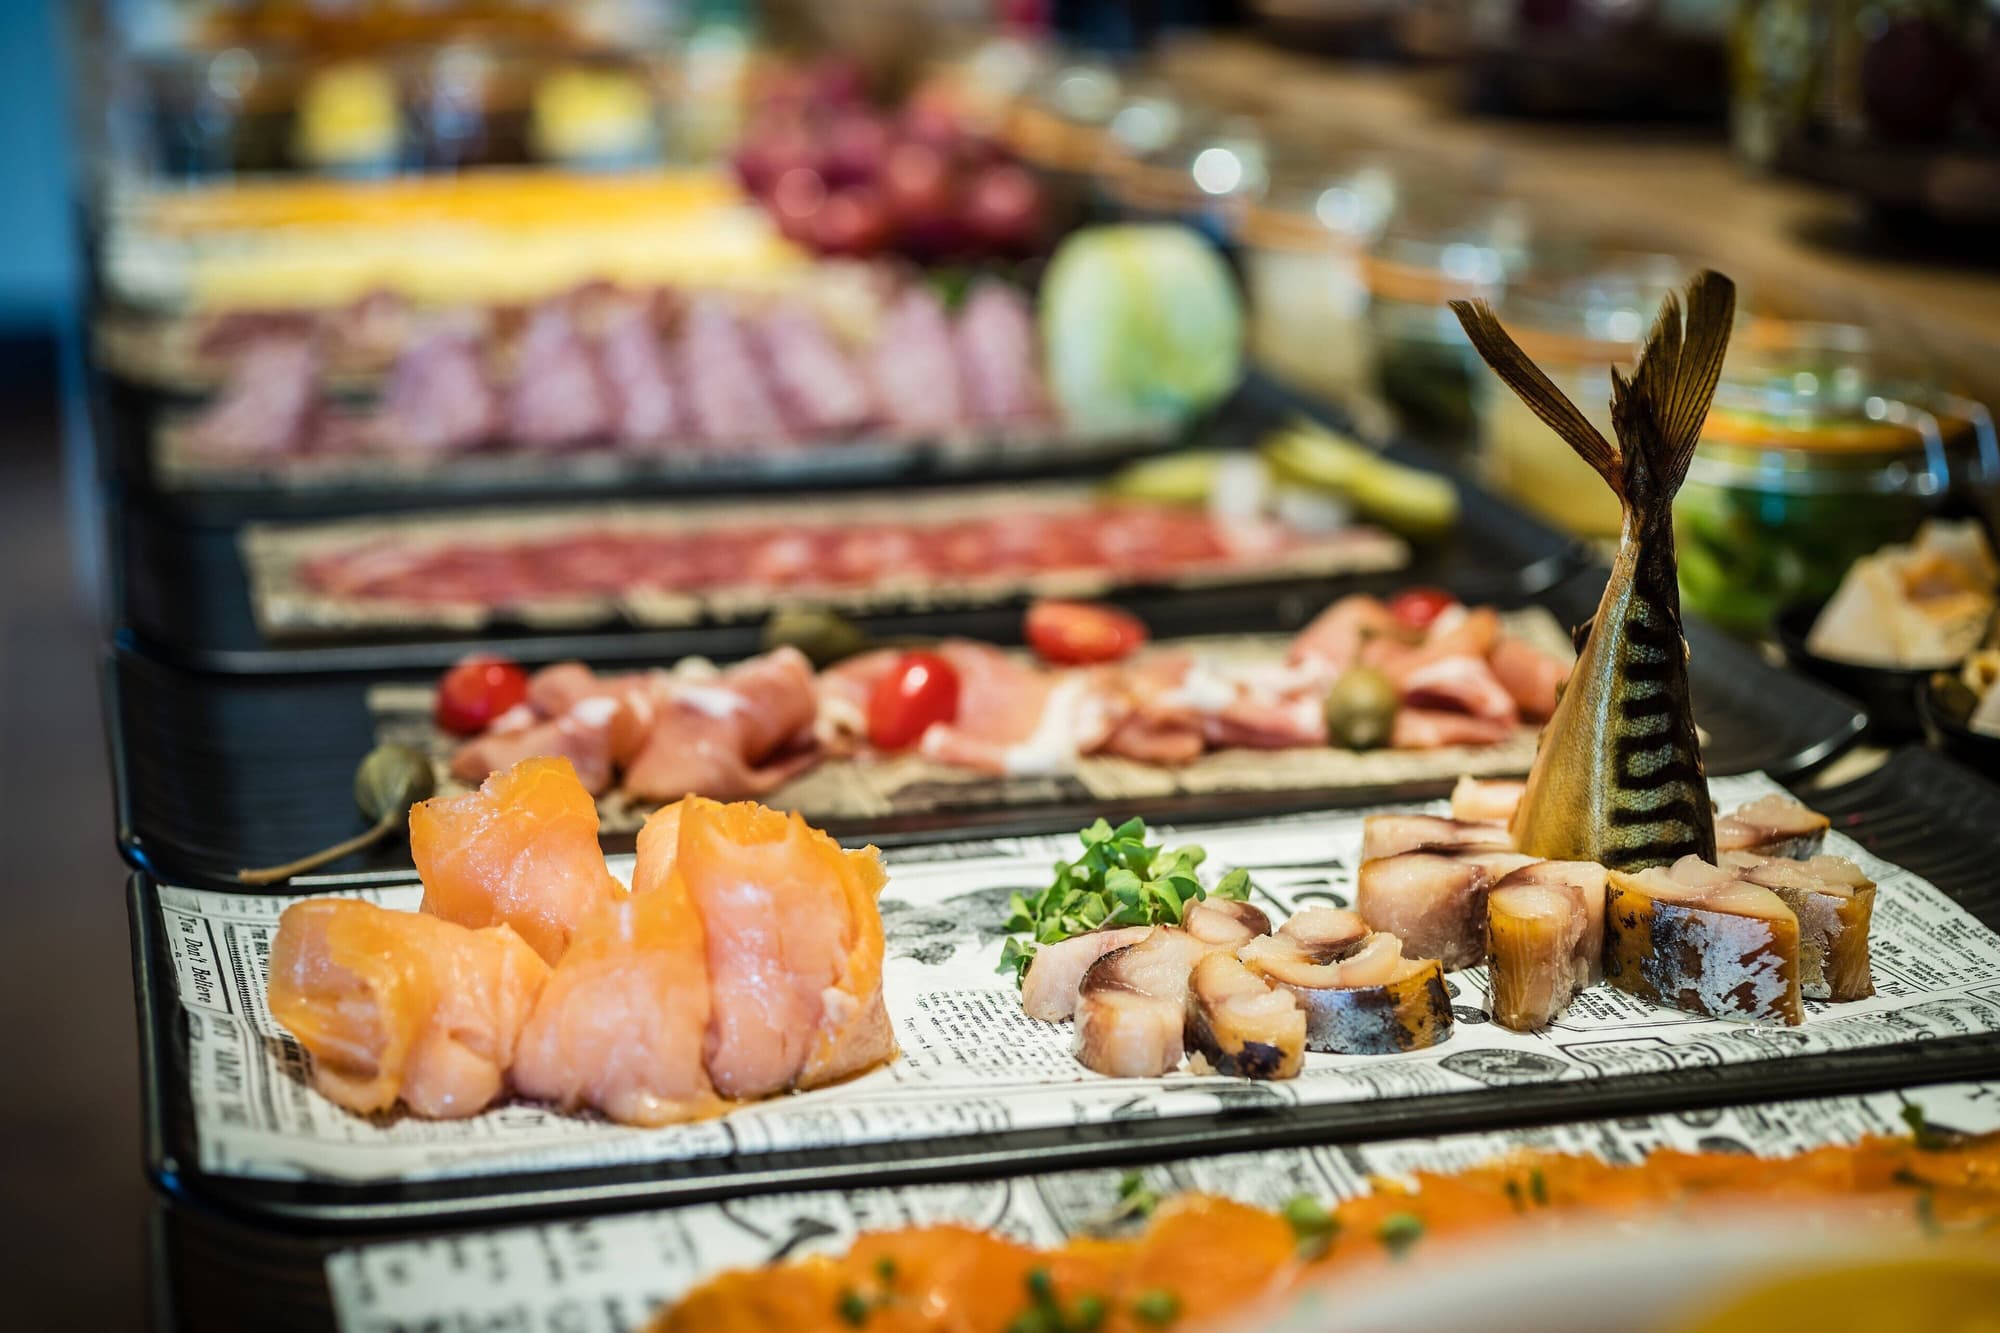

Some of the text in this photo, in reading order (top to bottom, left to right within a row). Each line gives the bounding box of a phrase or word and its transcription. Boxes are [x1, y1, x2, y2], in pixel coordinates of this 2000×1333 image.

[178, 915, 197, 935] You
[184, 937, 206, 967] Don't
[191, 966, 212, 1004] Believe
